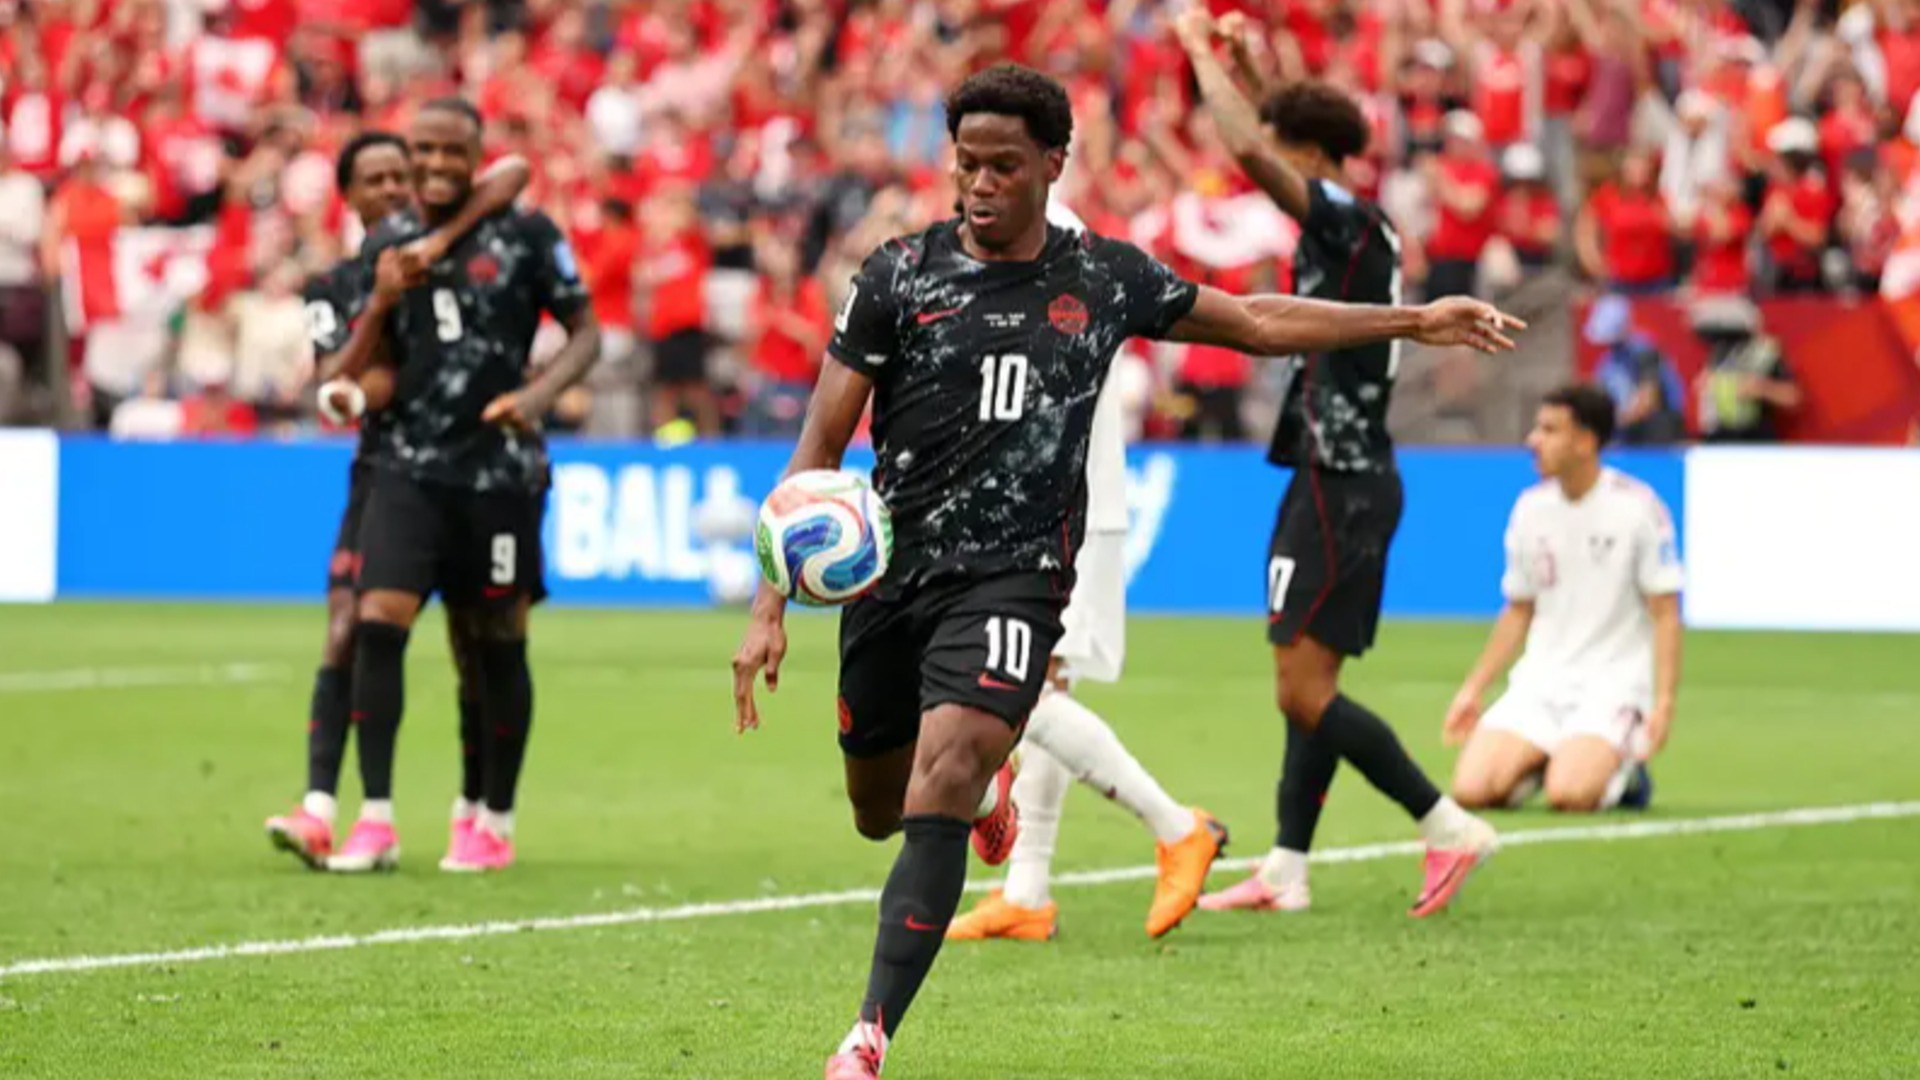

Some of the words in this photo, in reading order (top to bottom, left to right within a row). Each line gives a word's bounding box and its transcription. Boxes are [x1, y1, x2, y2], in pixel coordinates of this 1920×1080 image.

[433, 289, 462, 342] 9
[979, 354, 1028, 421] 10
[491, 533, 516, 585] 9
[985, 616, 1032, 682] 10
